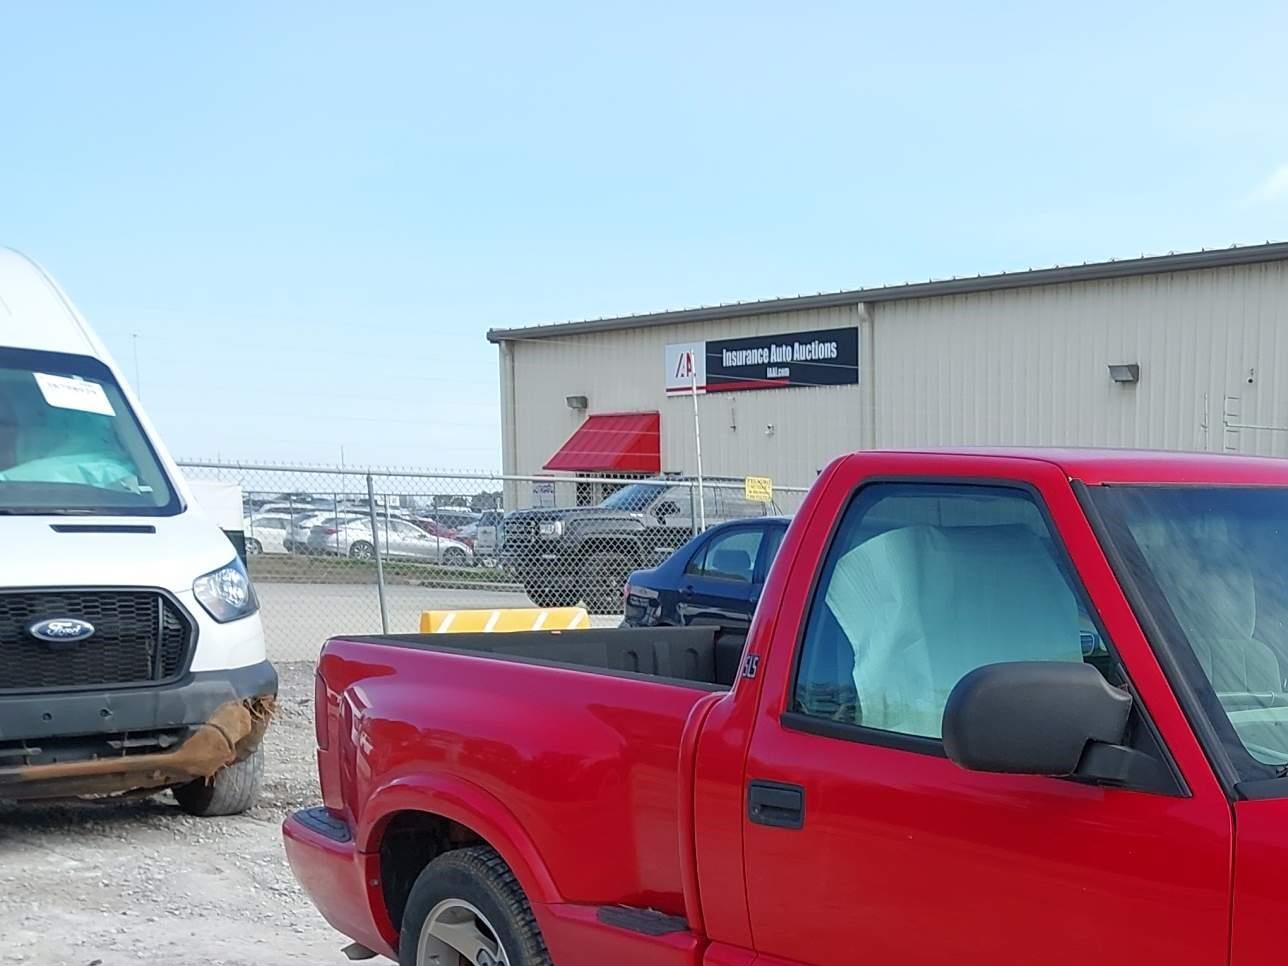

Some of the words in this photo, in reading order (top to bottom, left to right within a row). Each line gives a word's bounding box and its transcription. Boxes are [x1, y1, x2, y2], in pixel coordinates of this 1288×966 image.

[722, 347, 769, 367] Insurance
[770, 344, 792, 363] Auto
[793, 340, 838, 361] Auctions
[46, 620, 81, 636] Ford
